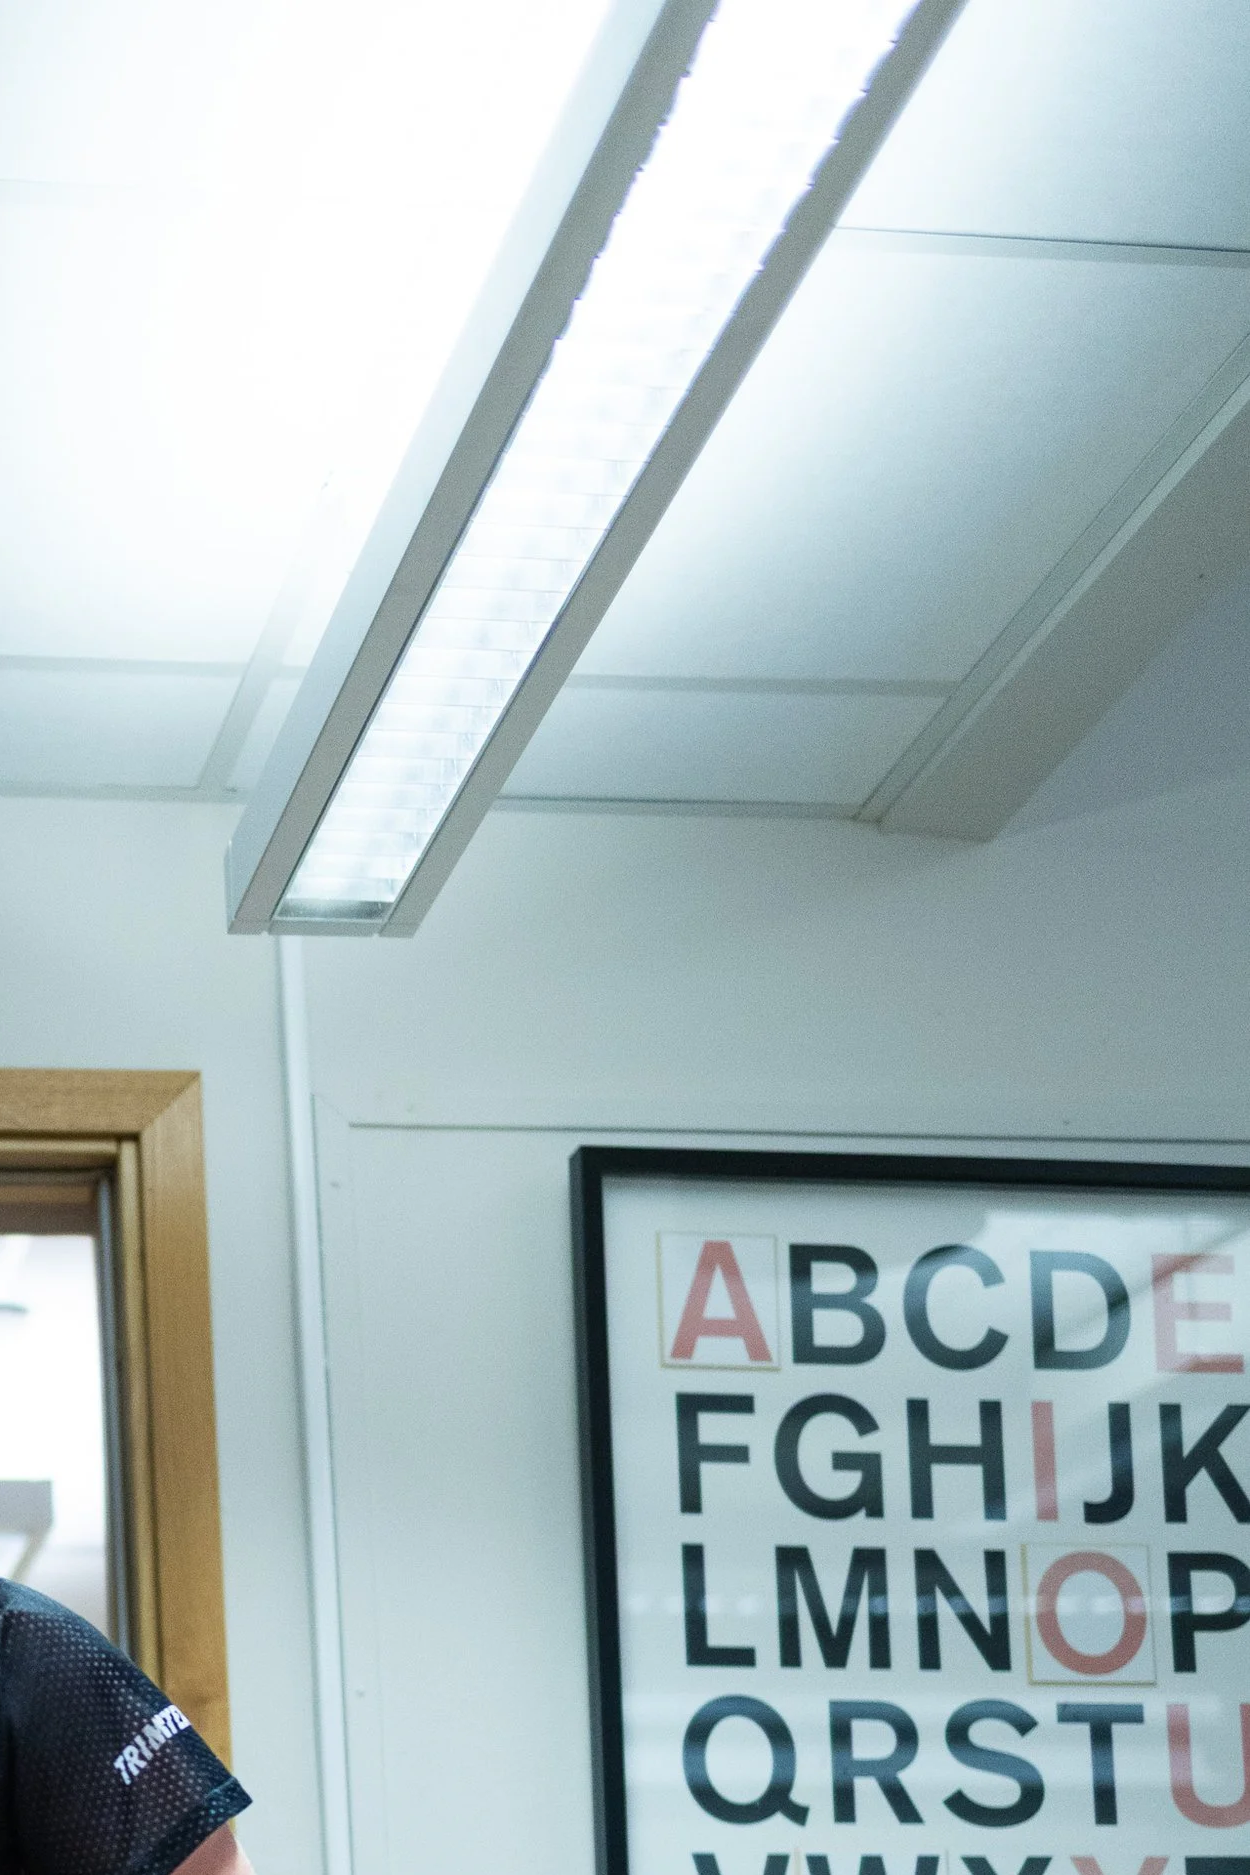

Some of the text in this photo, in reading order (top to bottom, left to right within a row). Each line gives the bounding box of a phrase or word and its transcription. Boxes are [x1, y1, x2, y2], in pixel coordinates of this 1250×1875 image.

[668, 1239, 1245, 1375] ABCDE
[675, 1391, 1250, 1525] FGHIJK
[681, 1542, 1250, 1675] LMNOP
[681, 1694, 1250, 1828] QRSTU
